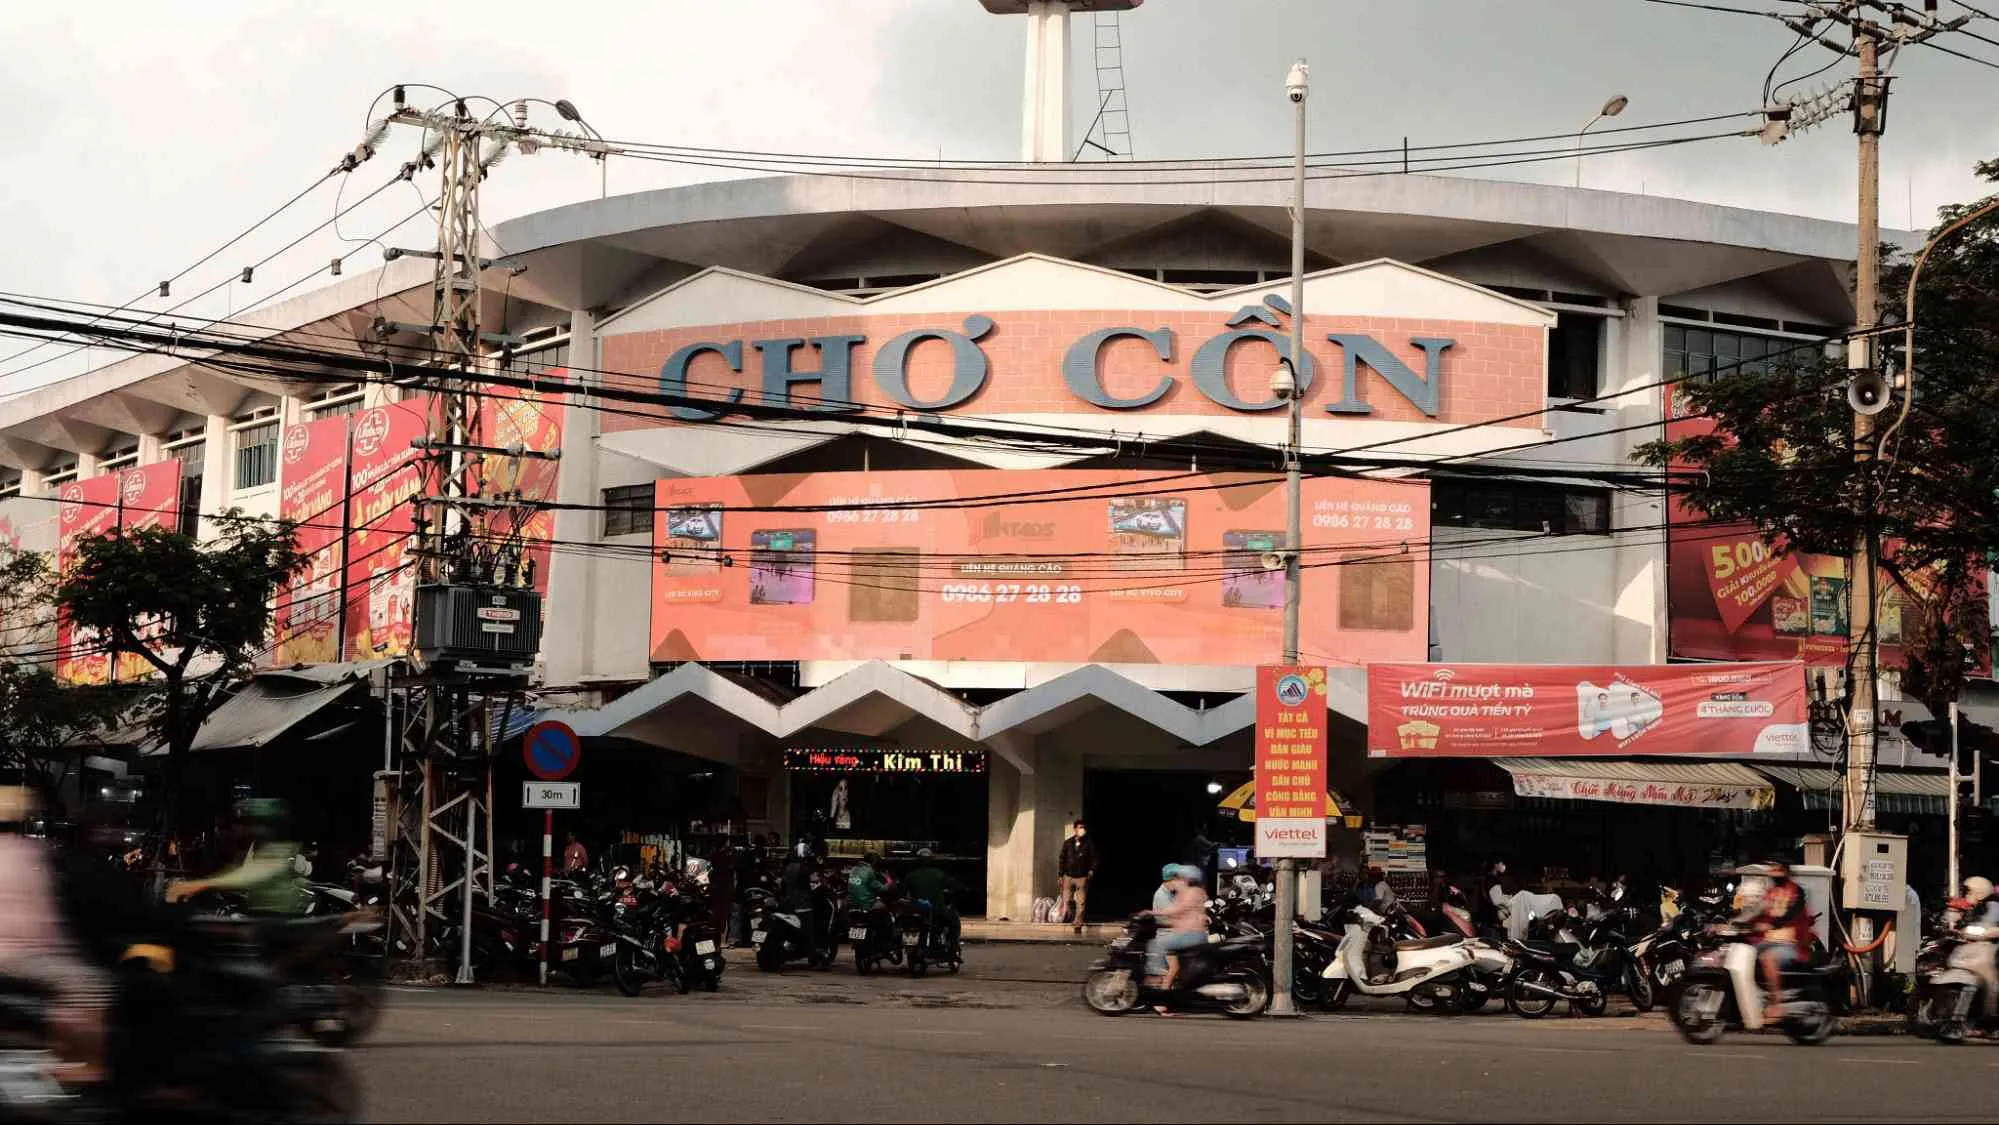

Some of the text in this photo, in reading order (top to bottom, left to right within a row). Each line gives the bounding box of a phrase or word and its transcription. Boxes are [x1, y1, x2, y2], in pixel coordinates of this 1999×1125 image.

[658, 294, 1454, 425] CHỢ CỒN
[1353, 515, 1369, 529] 27
[1374, 516, 1392, 529] 28
[1396, 516, 1414, 530] 28
[942, 584, 1082, 603] 0986 27 28 28
[1401, 681, 1534, 701] WiFi mượt mà
[1450, 704, 1483, 717] QUÀ
[884, 753, 922, 770] Kim
[930, 753, 962, 771] Thi
[541, 789, 563, 800] 30m
[1264, 828, 1319, 840] viettel
